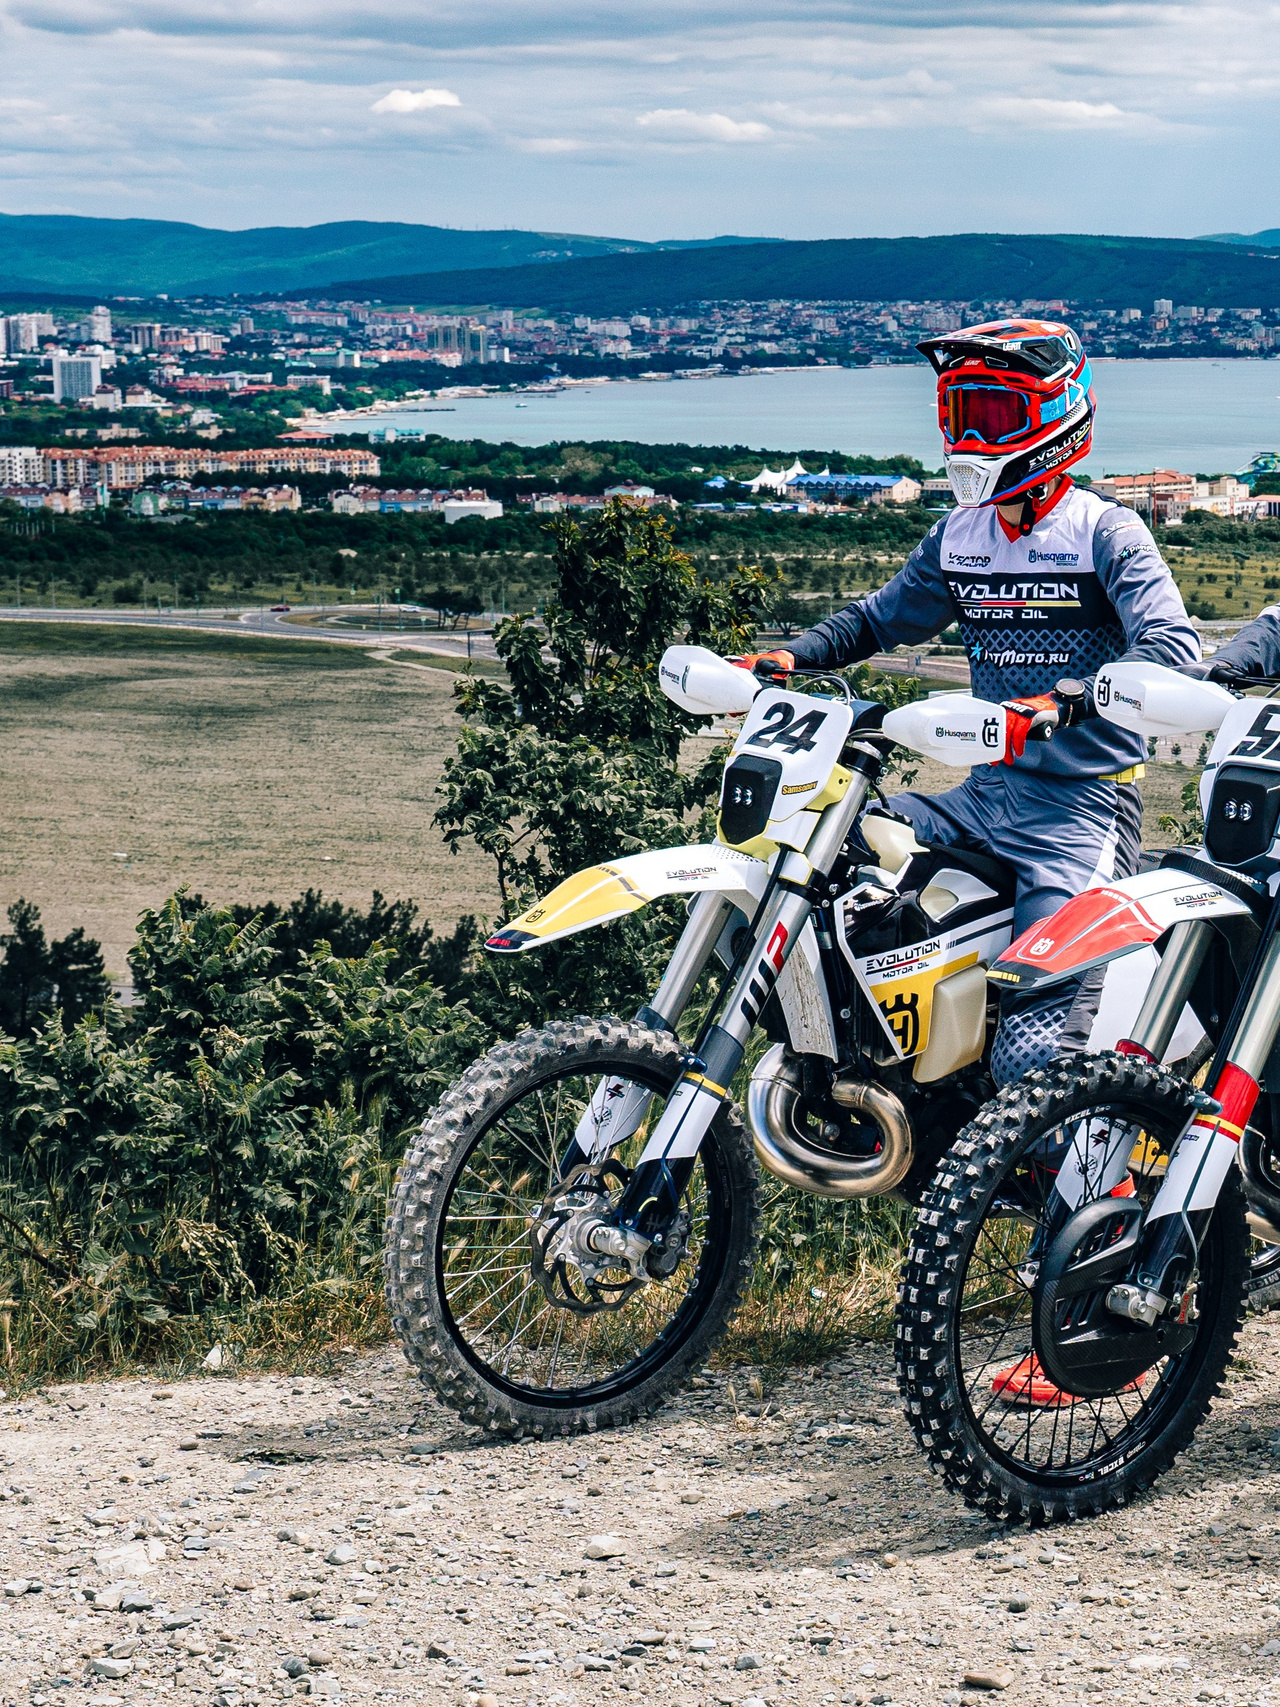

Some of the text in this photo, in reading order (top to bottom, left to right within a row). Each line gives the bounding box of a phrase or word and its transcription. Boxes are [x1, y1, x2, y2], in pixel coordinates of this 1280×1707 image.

[1029, 417, 1091, 468] EVOLUTION
[1045, 449, 1073, 470] MOTOR
[1037, 551, 1079, 563] Husqvarna
[964, 608, 1048, 619] MOTOR OIL
[745, 701, 828, 755] 24
[944, 729, 977, 738] Husqvarna
[666, 866, 718, 877] EVOLUTION
[1173, 890, 1223, 904] EVOLUTION
[866, 939, 942, 971] EVOLUTION
[882, 961, 930, 979] MOTOR OIL
[1065, 1108, 1091, 1125] EXCEL
[1098, 1455, 1125, 1475] EXCEL
